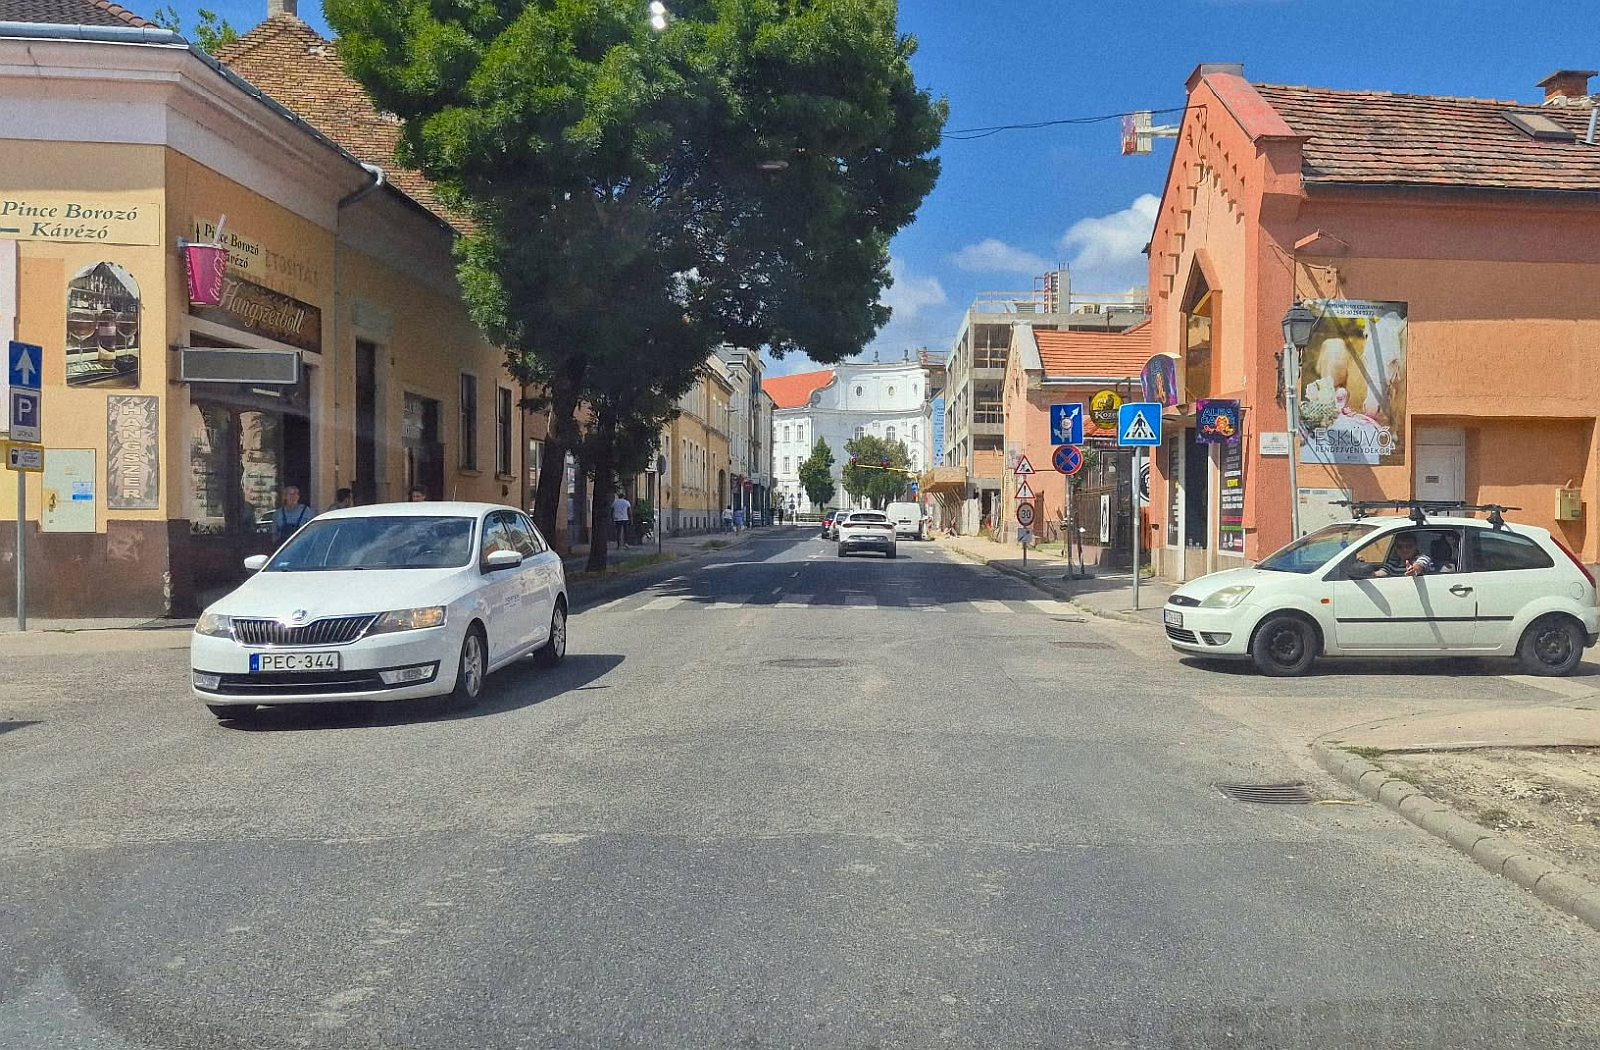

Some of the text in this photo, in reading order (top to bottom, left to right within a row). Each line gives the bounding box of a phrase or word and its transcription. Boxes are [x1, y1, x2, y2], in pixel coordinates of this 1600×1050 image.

[1, 201, 138, 221] Pince Borozó
[30, 222, 108, 239] Kávézó
[205, 223, 259, 256] Pice Borozó
[20, 398, 32, 422] P
[1314, 425, 1392, 447] ESKÜVŐ
[122, 403, 141, 499] HANGSZER
[262, 654, 334, 670] PEC-344
